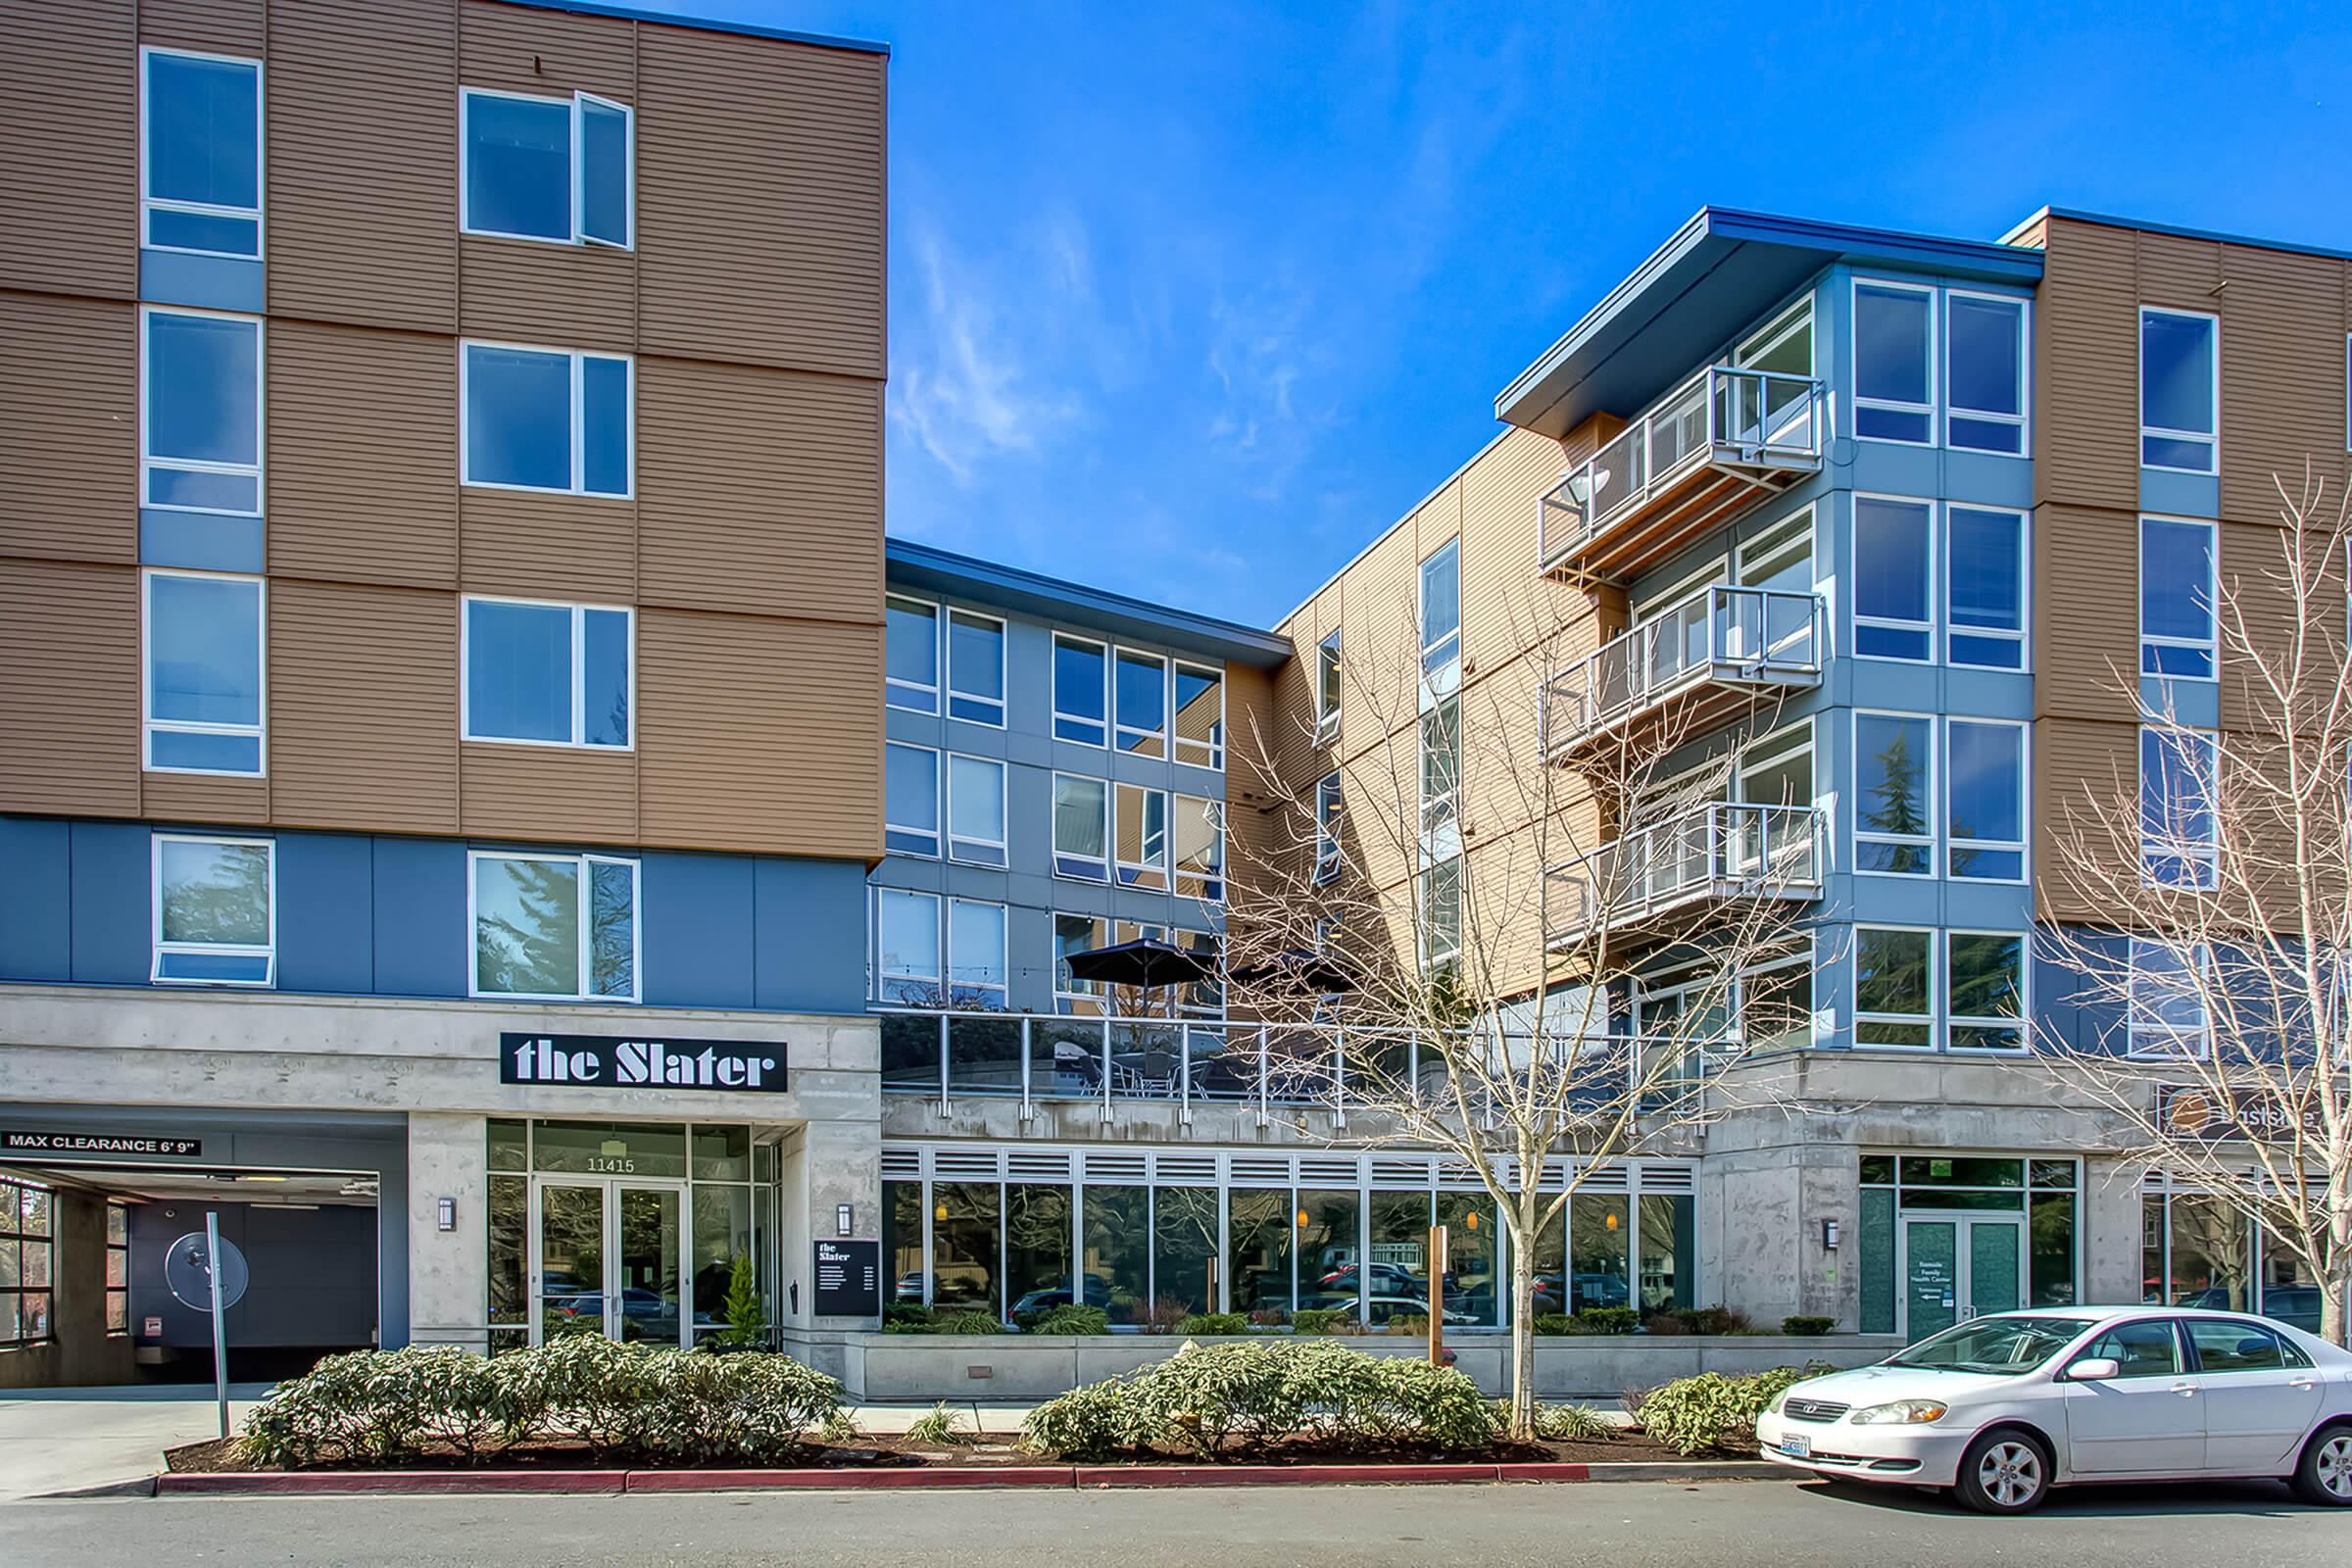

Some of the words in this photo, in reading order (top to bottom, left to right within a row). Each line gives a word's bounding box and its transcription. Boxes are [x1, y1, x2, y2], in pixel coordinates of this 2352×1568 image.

[514, 1039, 600, 1081] the
[615, 1042, 775, 1087] Slater
[2221, 1106, 2315, 1127] astsie
[10, 1135, 48, 1148] MAX
[52, 1137, 157, 1152] CLEARANCE
[587, 1158, 635, 1173] 11415
